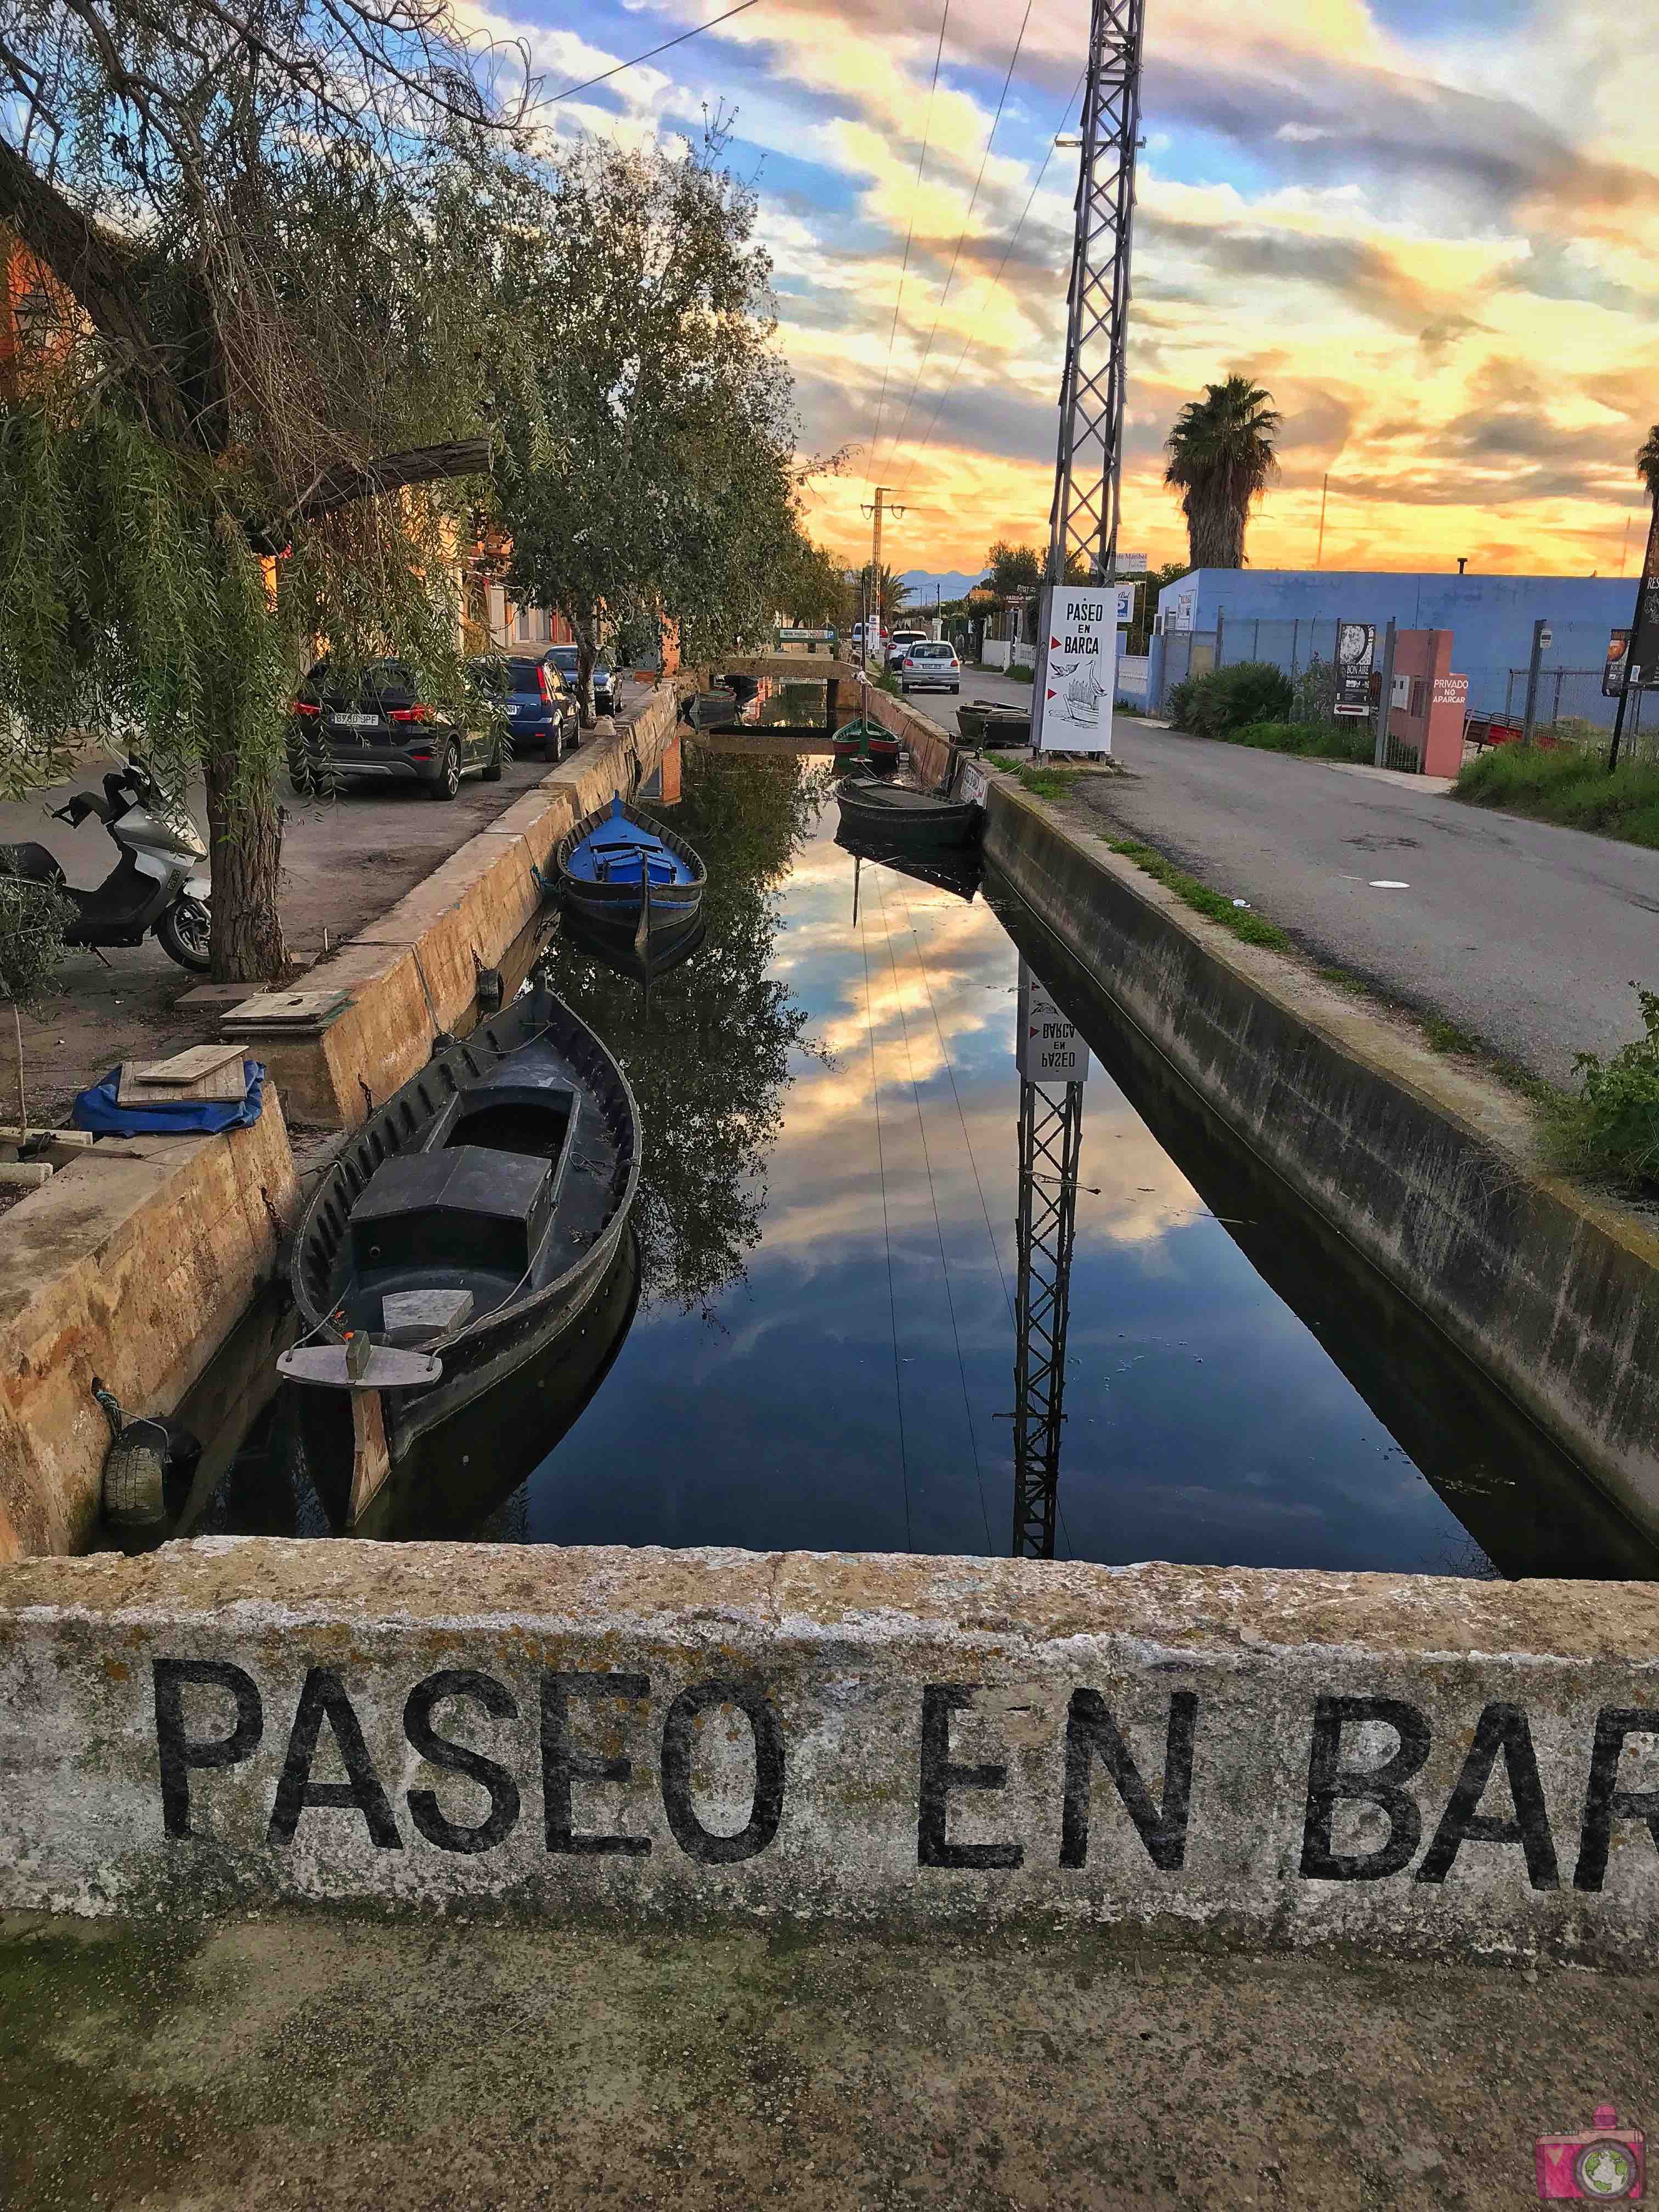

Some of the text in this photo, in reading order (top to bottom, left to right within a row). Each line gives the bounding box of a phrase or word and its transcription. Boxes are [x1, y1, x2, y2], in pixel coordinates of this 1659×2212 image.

[1066, 603, 1103, 622] PASEO
[1077, 624, 1090, 634] EN
[1064, 636, 1099, 654] BARCA
[1347, 666, 1357, 674] BON
[1434, 679, 1469, 689] PRIVADO
[152, 1657, 1659, 1893] PASEO EN BAR
